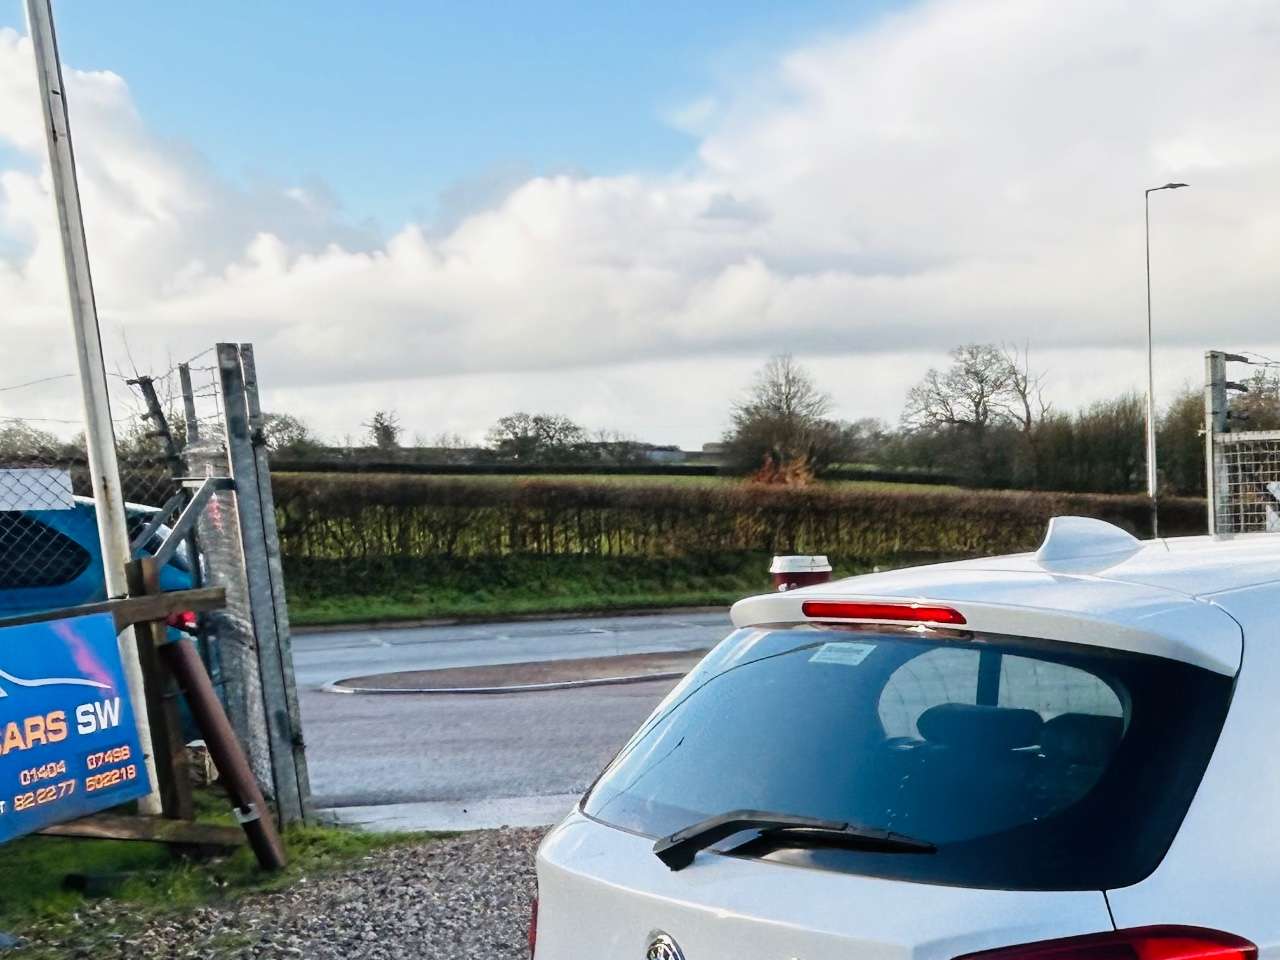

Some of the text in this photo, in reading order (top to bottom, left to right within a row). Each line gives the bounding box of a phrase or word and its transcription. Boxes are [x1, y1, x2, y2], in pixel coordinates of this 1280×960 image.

[0, 697, 120, 756] ARS SW
[20, 759, 67, 786] 01404
